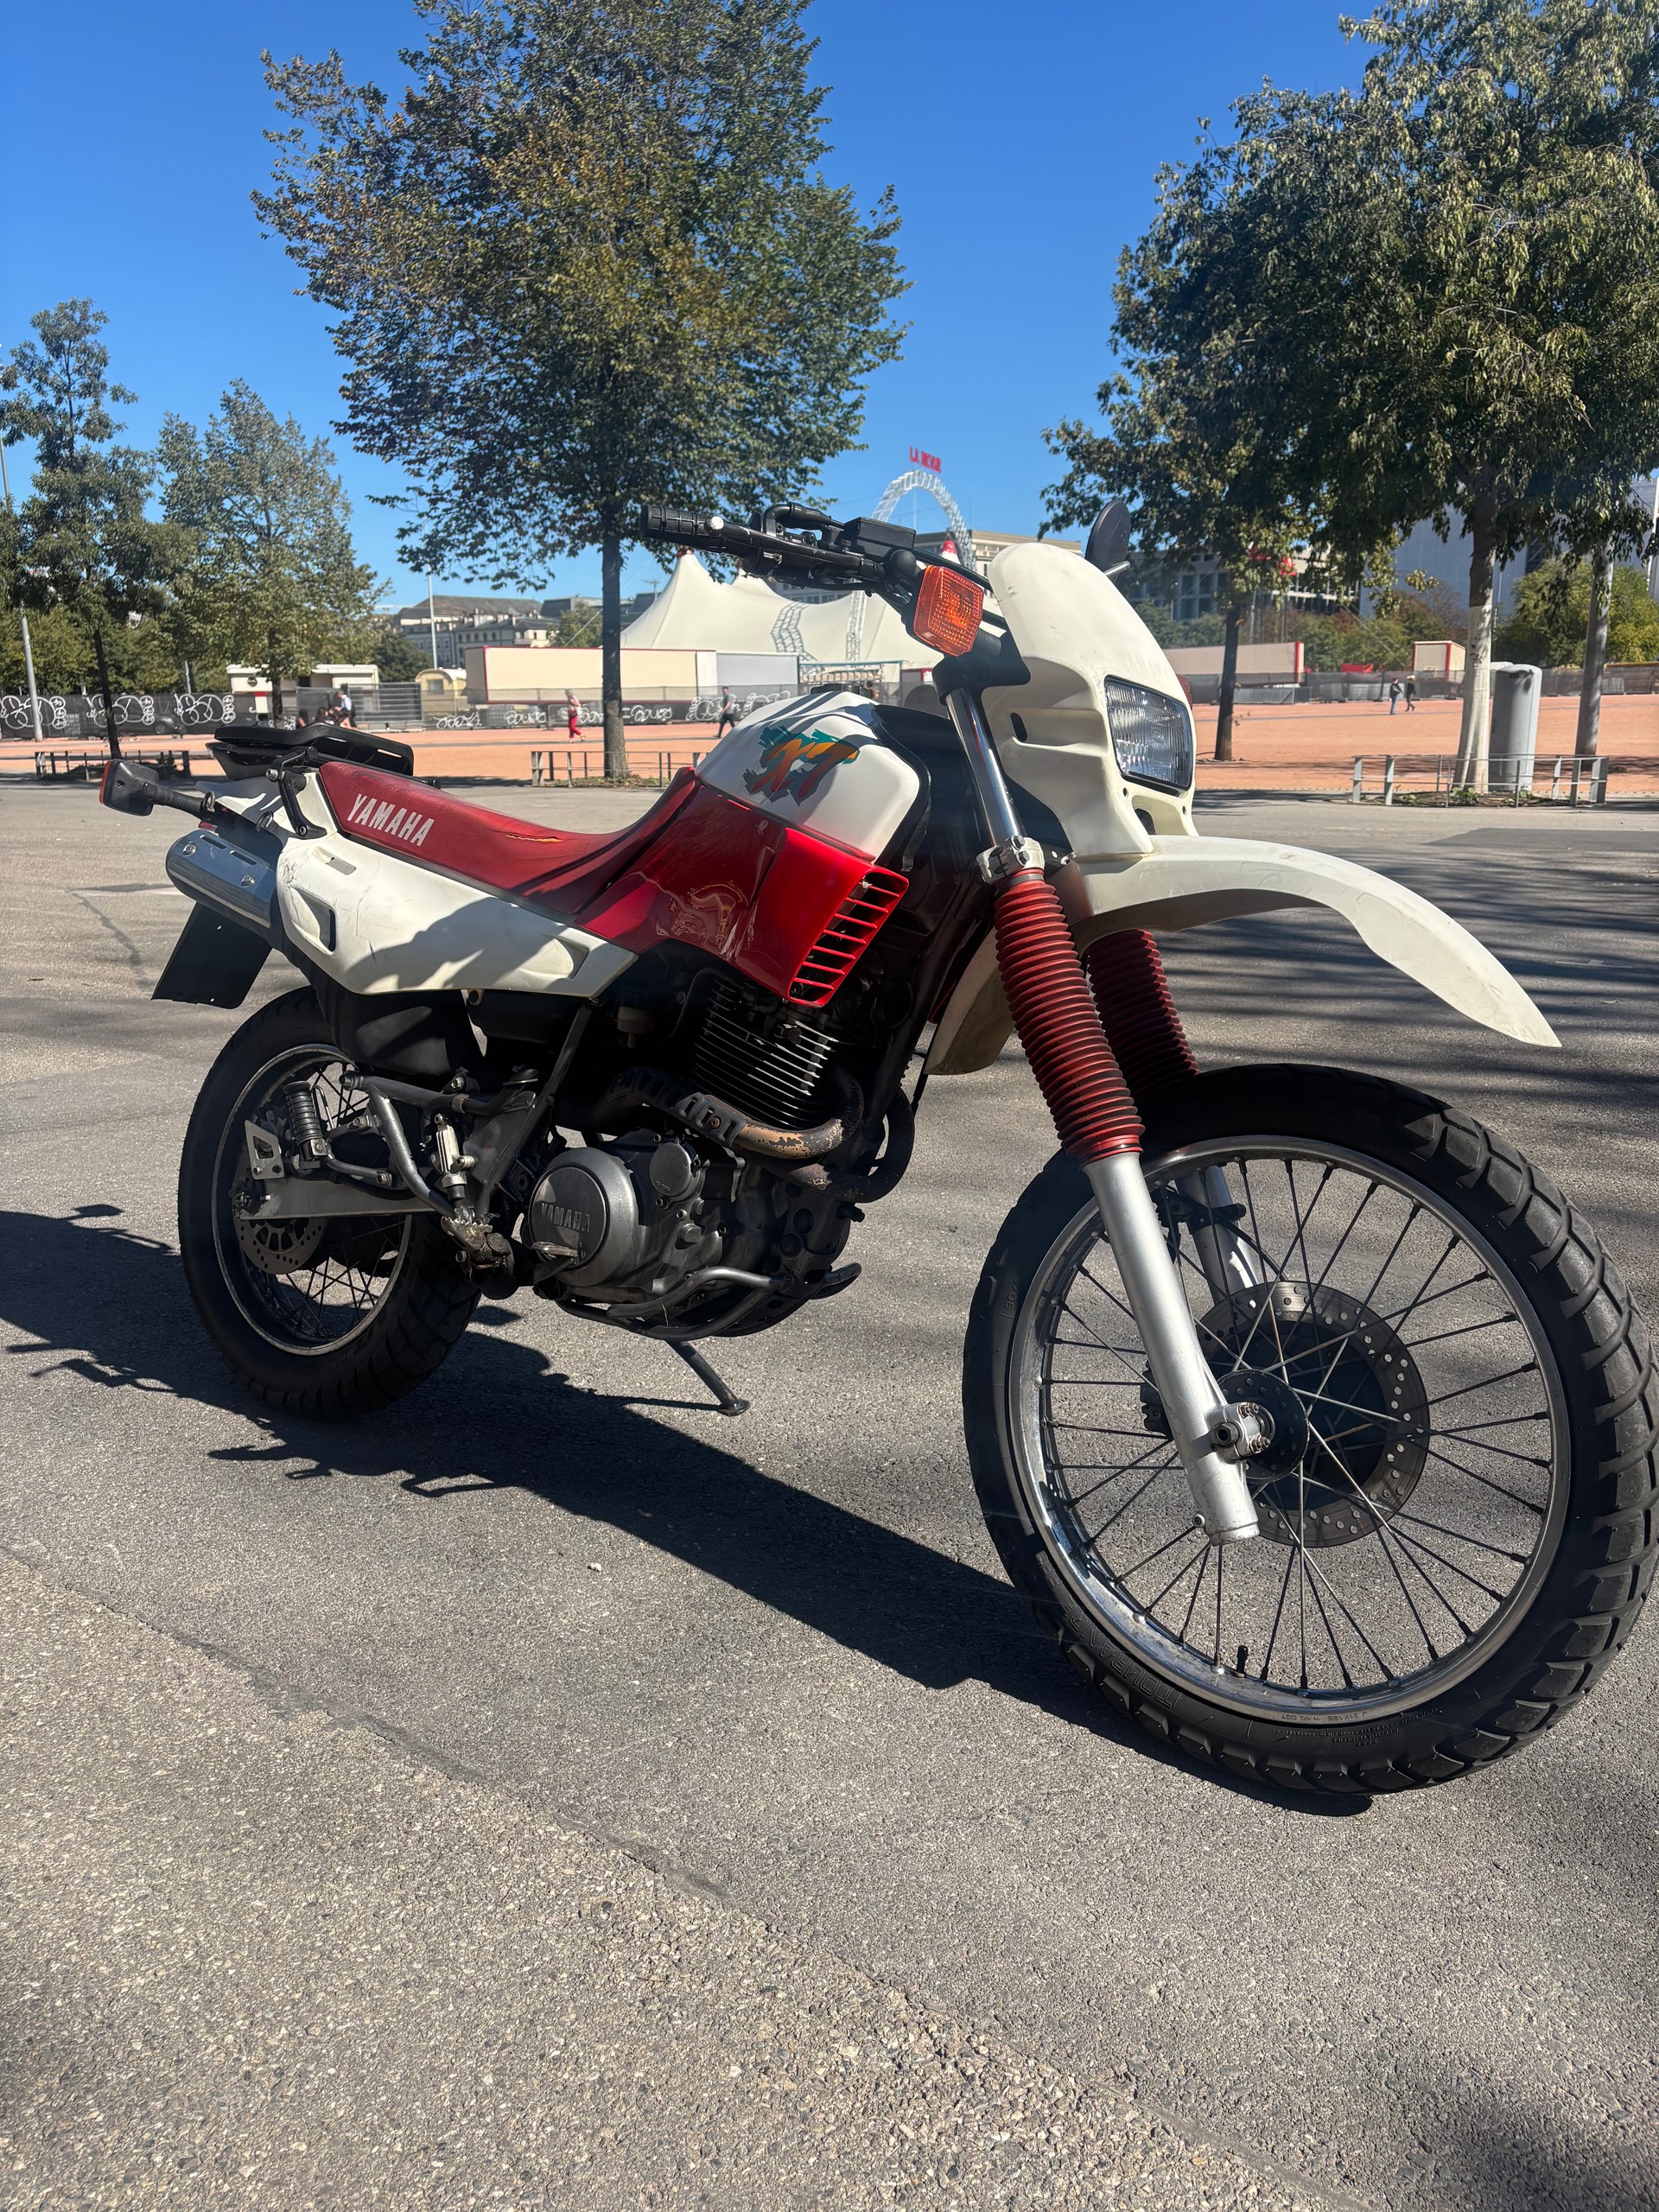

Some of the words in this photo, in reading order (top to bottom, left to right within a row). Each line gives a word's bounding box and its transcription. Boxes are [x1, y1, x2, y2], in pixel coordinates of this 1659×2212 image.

[750, 737, 858, 798] XT
[346, 793, 435, 847] YAMAHA
[542, 1202, 590, 1233] YAMAHA
